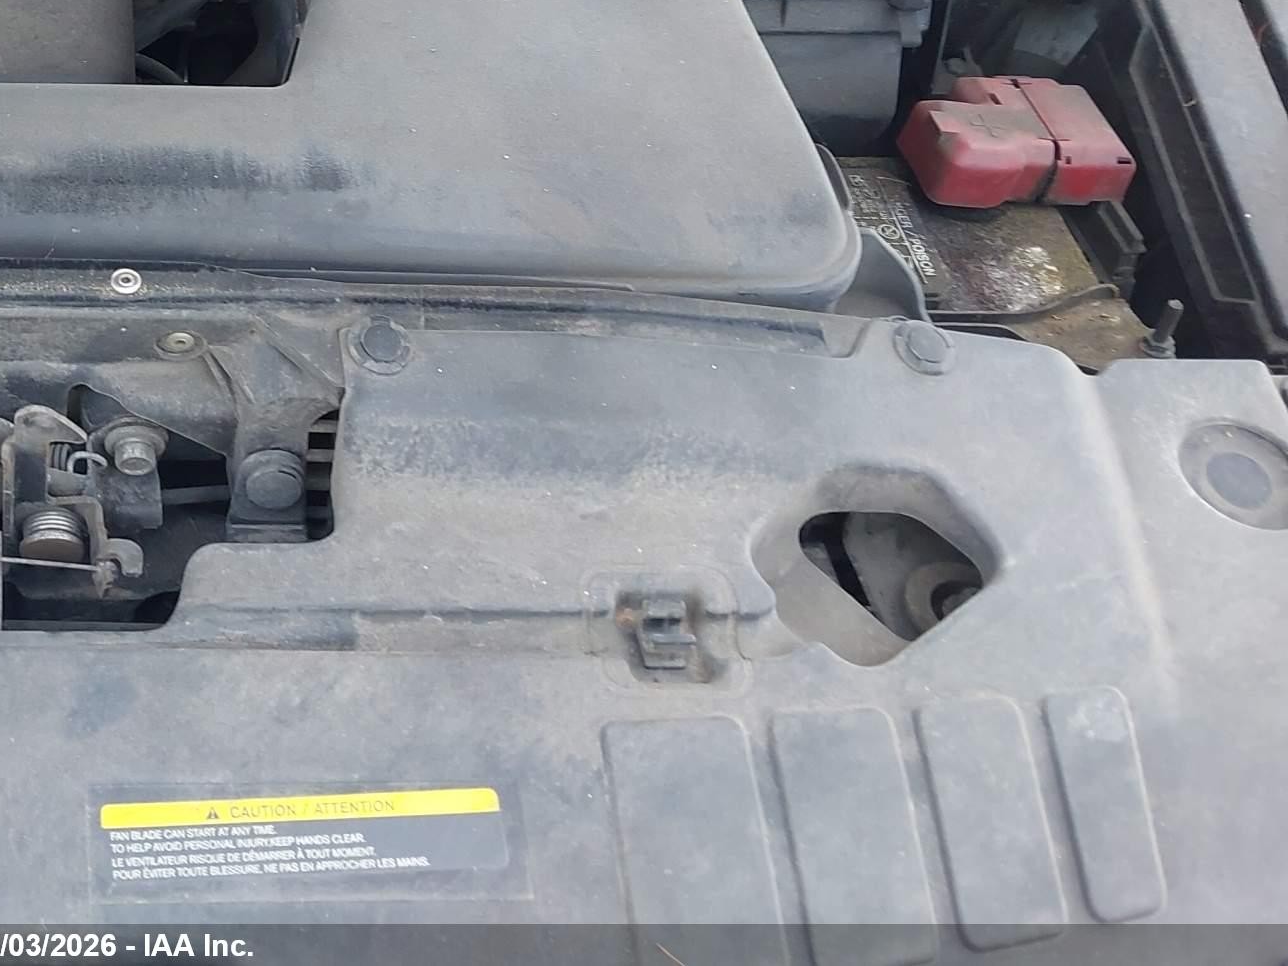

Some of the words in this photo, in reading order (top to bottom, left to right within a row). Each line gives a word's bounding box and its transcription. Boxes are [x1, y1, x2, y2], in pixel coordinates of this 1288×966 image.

[911, 237, 937, 276] POISON
[230, 803, 297, 819] CAUTION
[314, 799, 396, 815] ATTENTION
[110, 830, 130, 842] FAN
[131, 829, 163, 841] BLADE
[164, 827, 187, 840] CAN
[187, 826, 216, 839] START
[218, 826, 230, 837] AT
[231, 825, 251, 837] ANY
[110, 843, 125, 854] TO
[127, 841, 152, 854] HELP
[153, 840, 183, 853] AVOID
[184, 838, 236, 851] PERSONAL
[296, 834, 331, 846] HANDS
[112, 857, 125, 868] LE
[125, 855, 188, 868] VENTILATEUR
[189, 852, 226, 865] RISQUE
[227, 851, 241, 863] DE
[242, 849, 296, 863] DÉMARRER
[297, 846, 305, 860] À
[305, 847, 330, 859] TOUT
[112, 868, 142, 881] POUR
[176, 865, 209, 878] TOUTE
[263, 863, 278, 874] NE
[279, 862, 300, 873] PAS
[300, 861, 314, 872] EN
[315, 858, 377, 872] APPROCHER
[377, 857, 396, 869] LES
